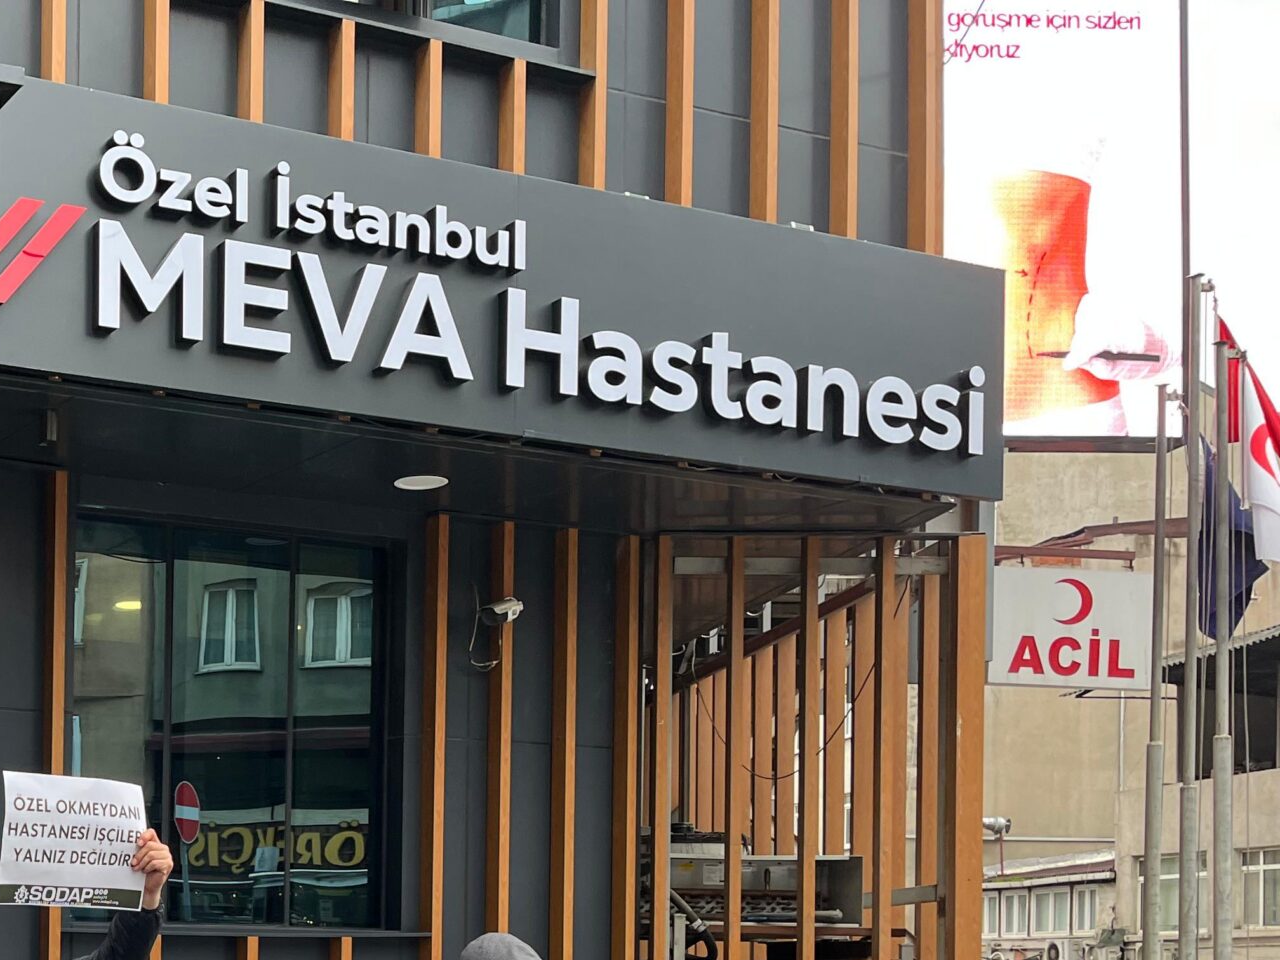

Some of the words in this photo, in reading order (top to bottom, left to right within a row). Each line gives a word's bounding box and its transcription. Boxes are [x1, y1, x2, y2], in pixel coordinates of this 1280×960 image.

[94, 130, 249, 225] Özel
[272, 160, 526, 271] İstanbul
[92, 218, 474, 382] MEVA
[496, 285, 985, 458] Hastanesi
[1007, 628, 1135, 679] ACİL
[13, 794, 51, 813] ÖZEL
[56, 800, 141, 821] OKMEYDANI
[7, 821, 90, 841] HASTANESİ
[13, 847, 66, 864] YALNIZ
[29, 885, 94, 904] SODAP
